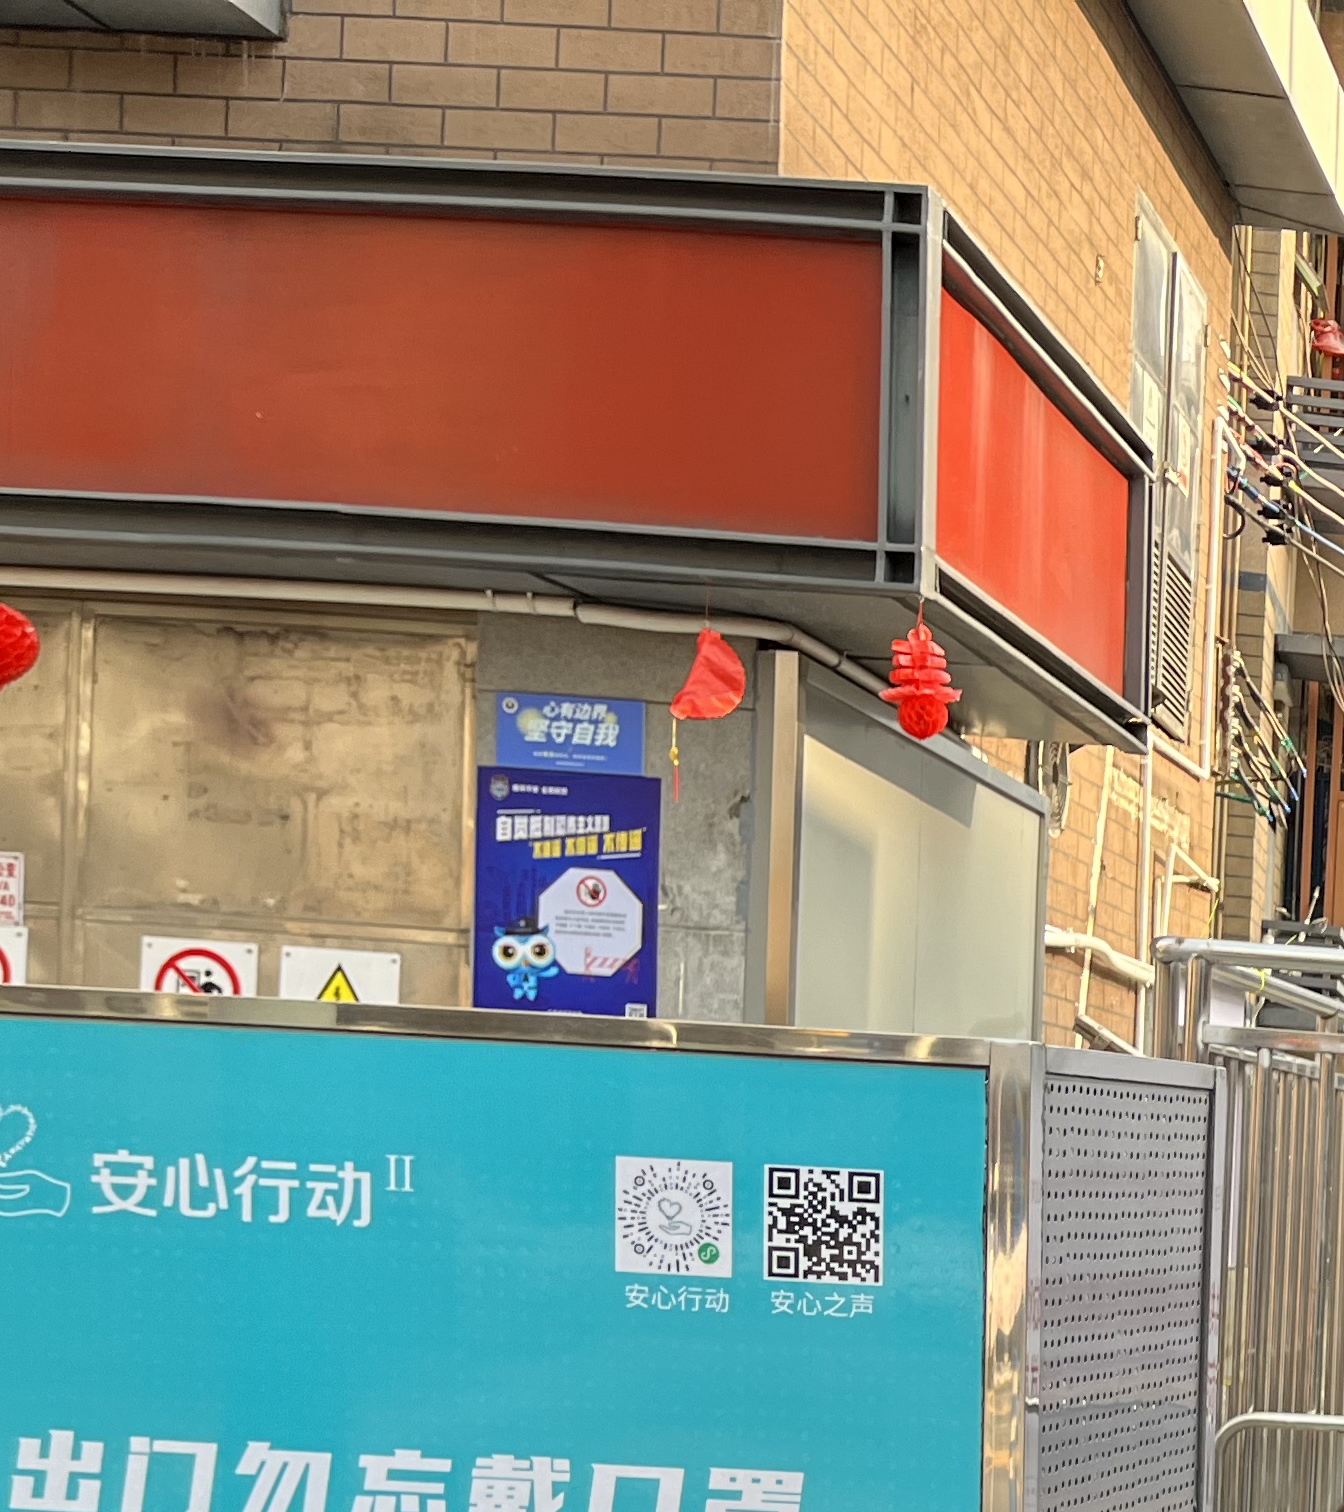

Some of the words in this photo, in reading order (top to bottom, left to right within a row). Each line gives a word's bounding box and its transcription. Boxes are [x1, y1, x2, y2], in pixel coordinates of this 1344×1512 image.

[542, 701, 608, 721] 心有边界
[524, 718, 620, 747] 坚守自我
[90, 1149, 371, 1228] 安心行动
[624, 1283, 730, 1313] 安心行动
[770, 1289, 875, 1318] 安心之声
